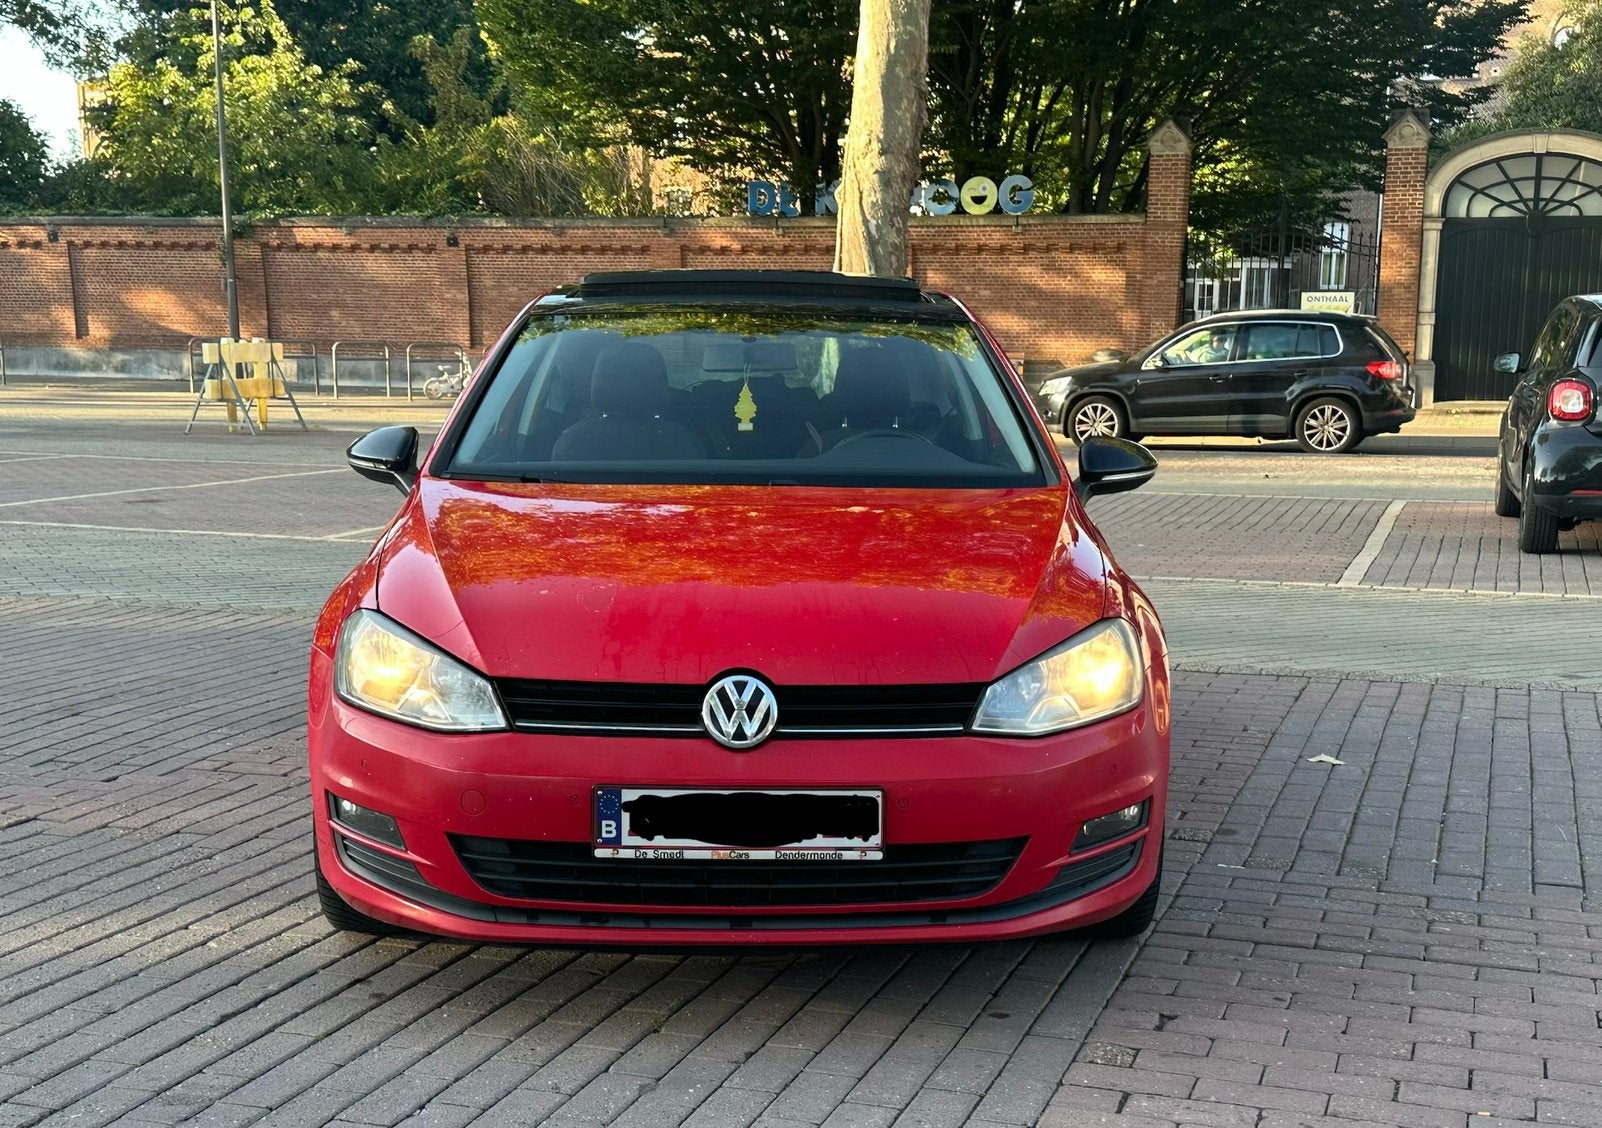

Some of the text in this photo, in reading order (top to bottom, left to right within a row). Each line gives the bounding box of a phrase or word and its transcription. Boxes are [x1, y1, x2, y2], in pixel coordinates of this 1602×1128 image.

[1306, 295, 1349, 303] ONTHAAL
[702, 674, 778, 748] VW
[601, 820, 617, 838] B
[634, 849, 648, 859] De
[775, 849, 843, 860] Dendermonde
